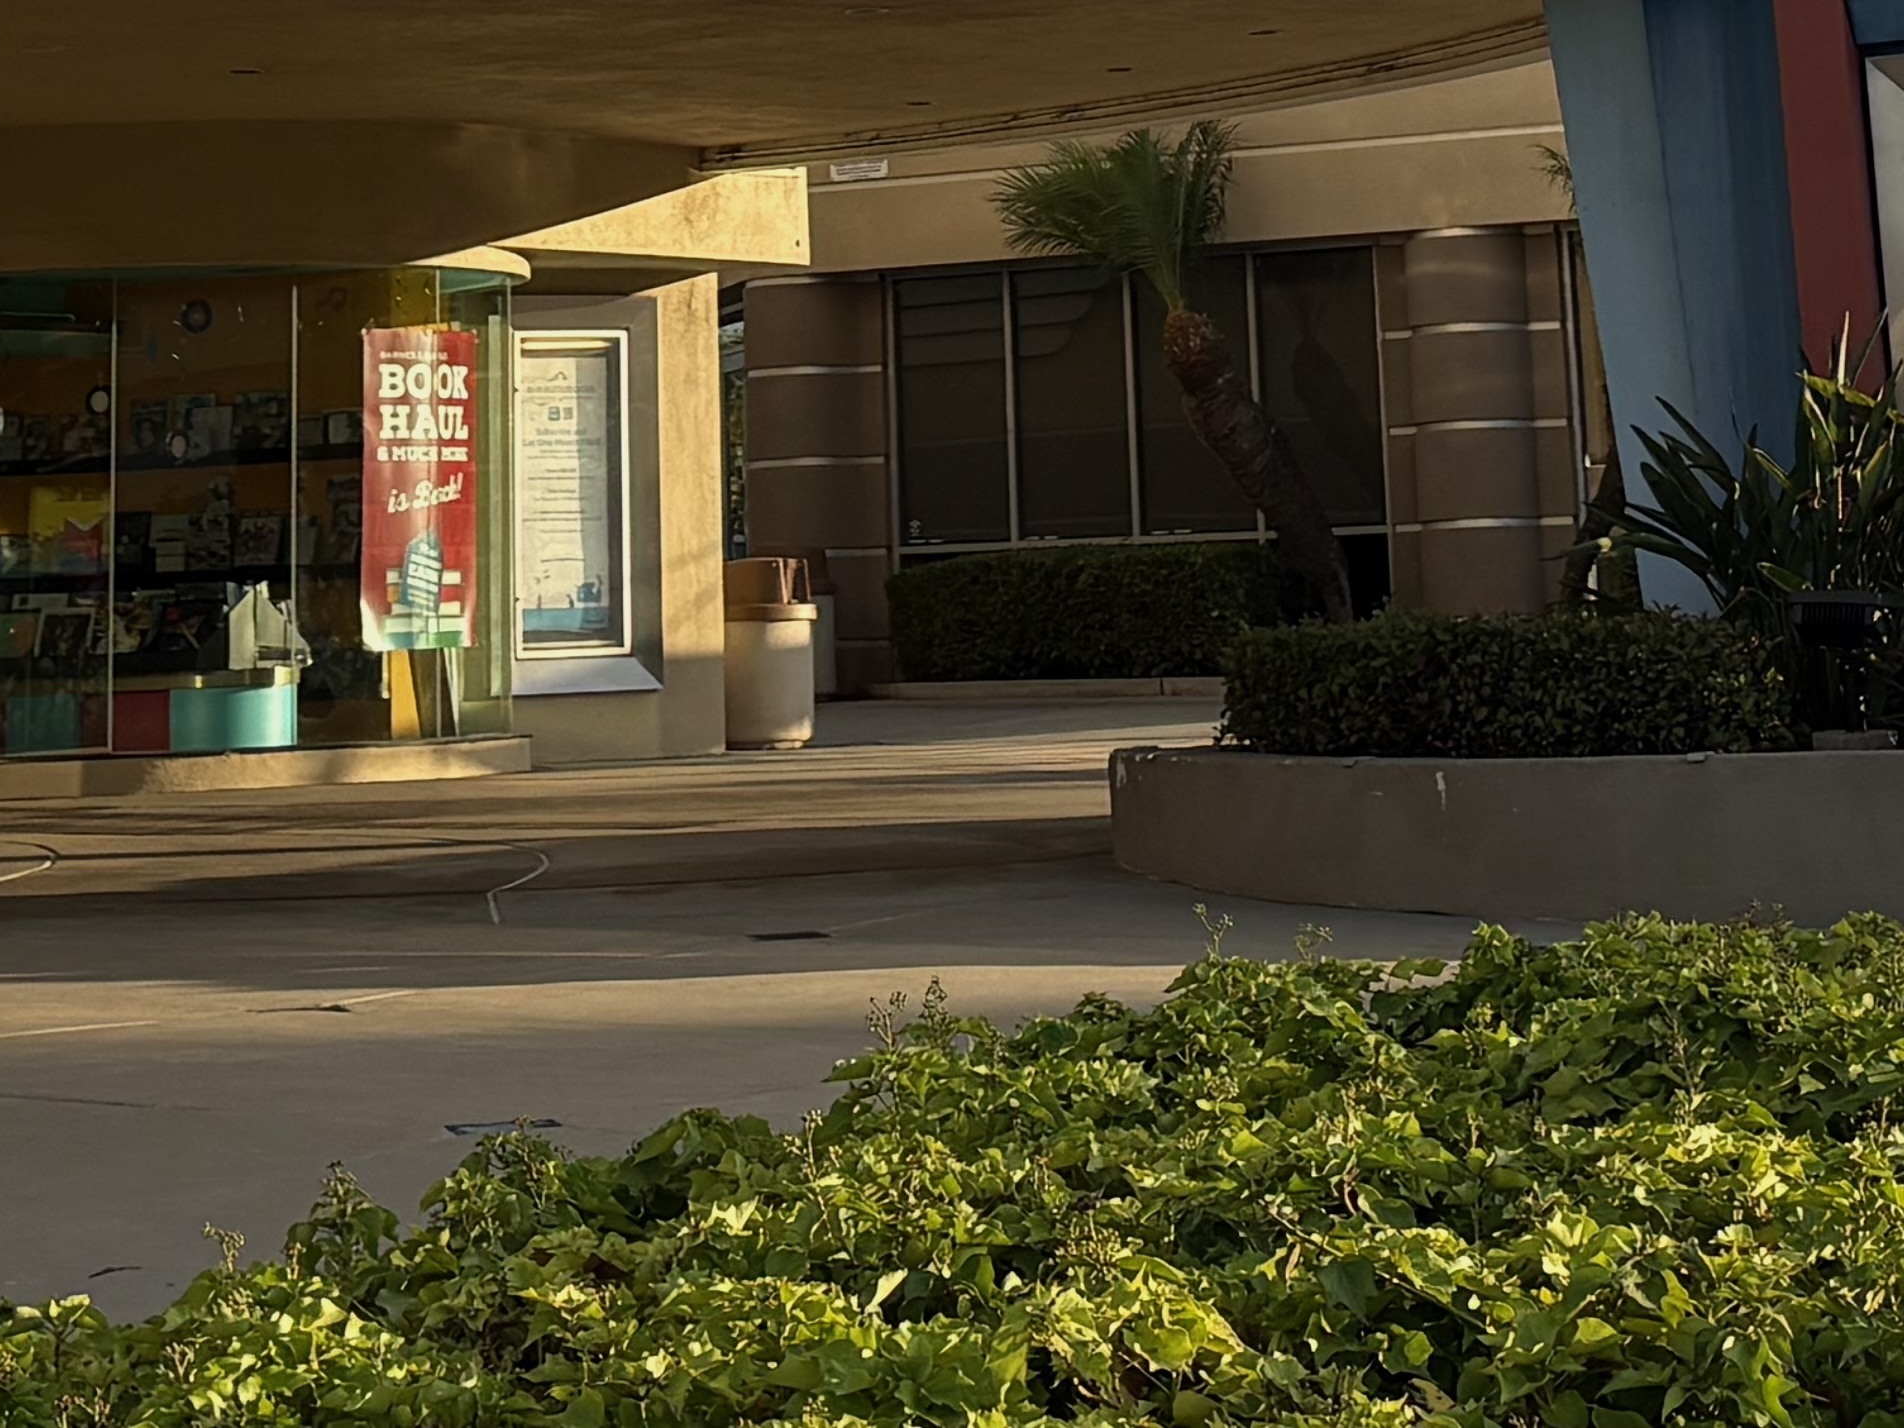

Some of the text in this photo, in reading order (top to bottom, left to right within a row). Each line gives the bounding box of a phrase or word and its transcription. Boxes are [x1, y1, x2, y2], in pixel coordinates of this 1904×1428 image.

[378, 363, 469, 400] BOOK
[379, 404, 469, 440] HAUL
[387, 488, 411, 513] is
